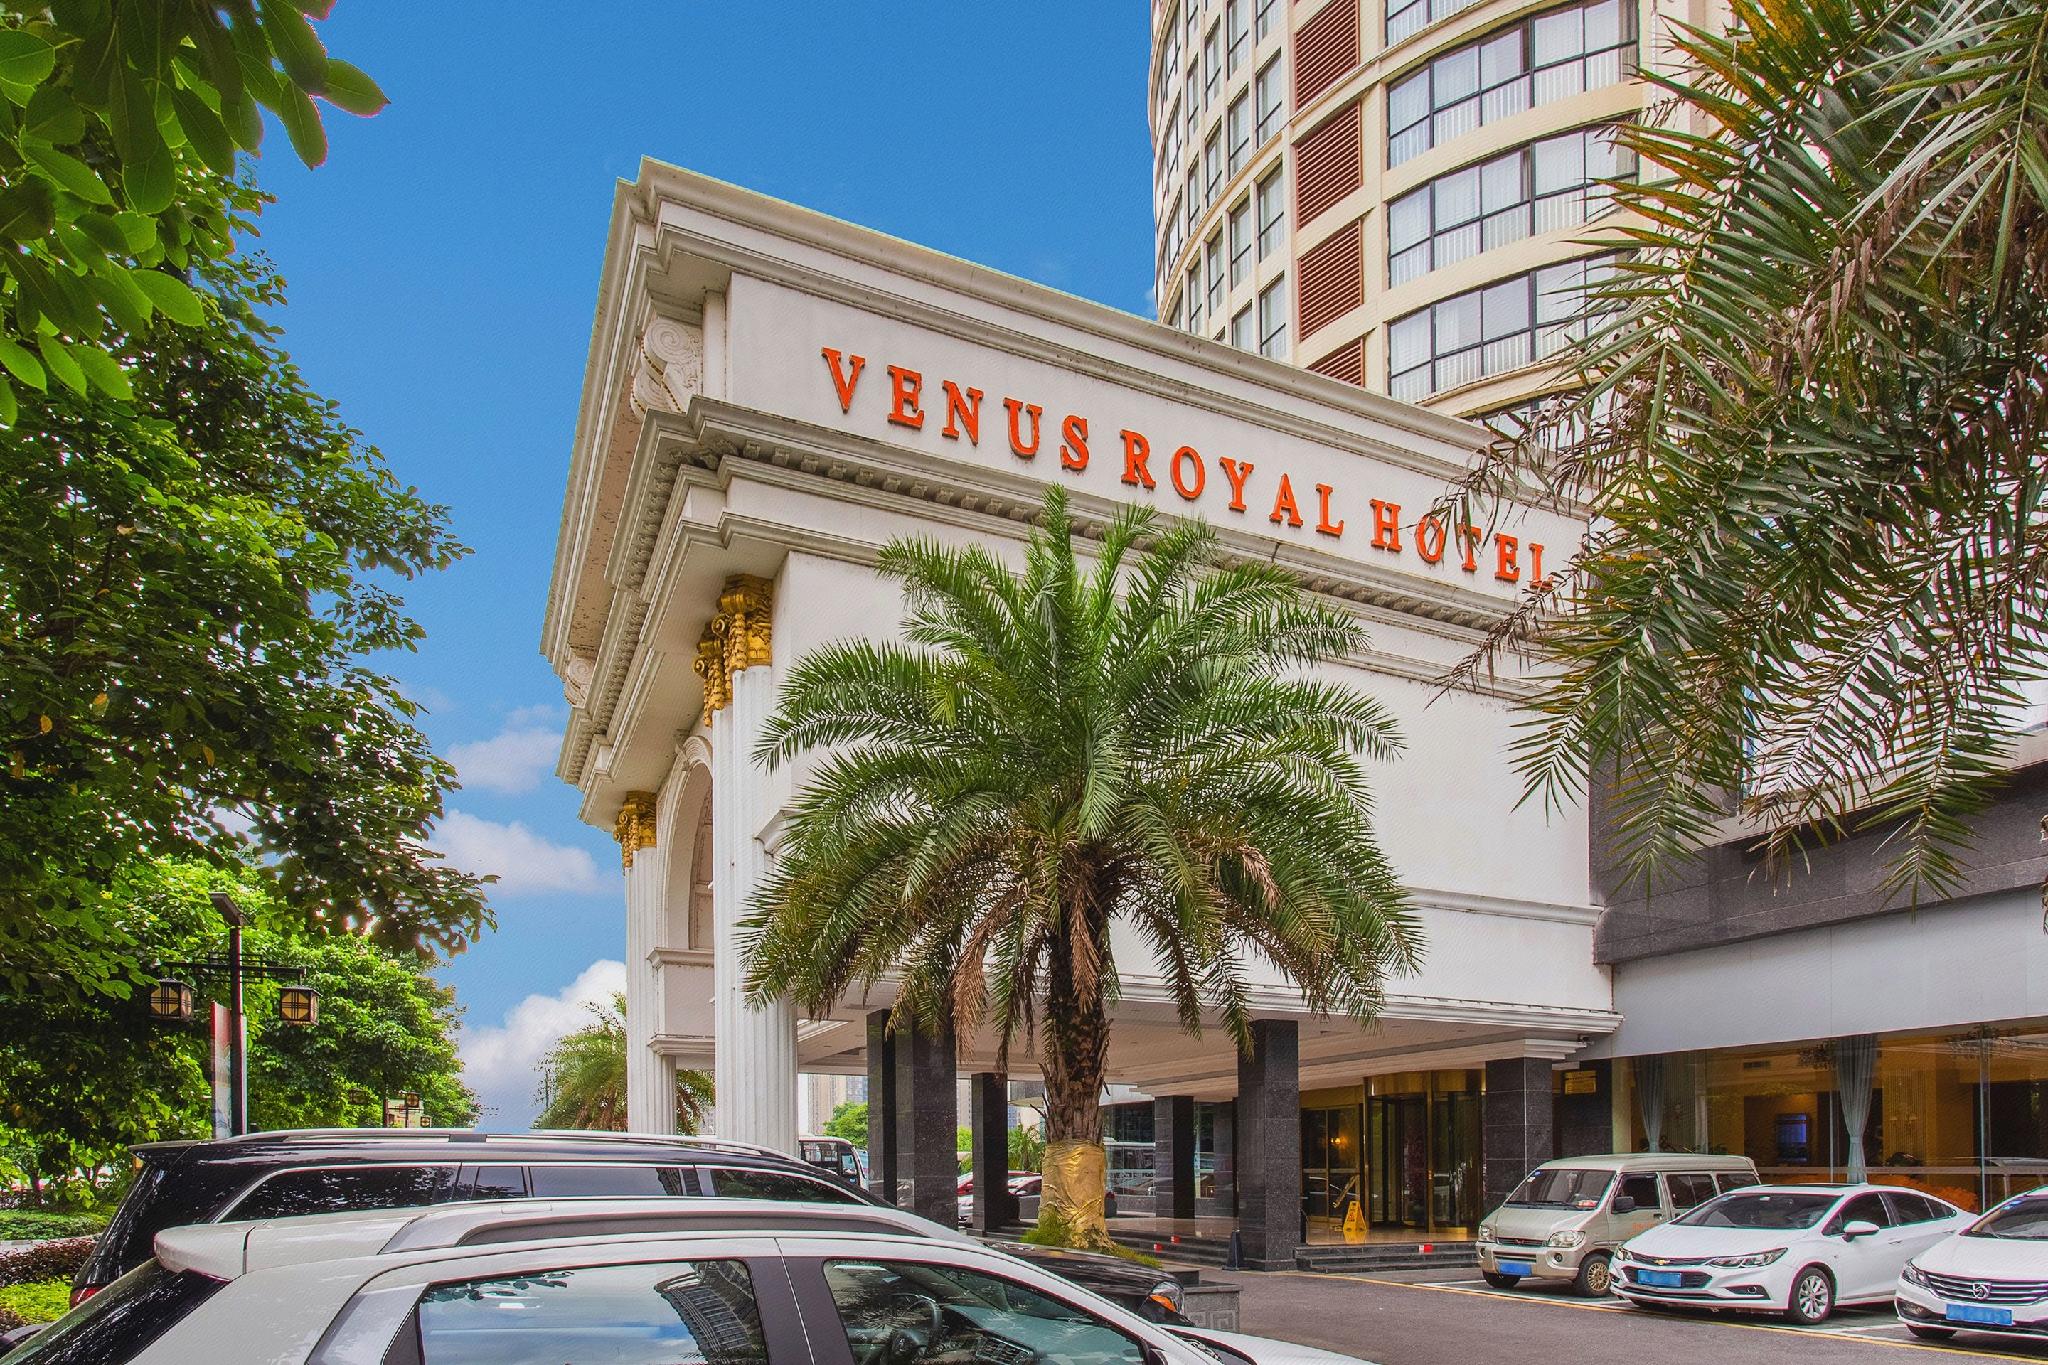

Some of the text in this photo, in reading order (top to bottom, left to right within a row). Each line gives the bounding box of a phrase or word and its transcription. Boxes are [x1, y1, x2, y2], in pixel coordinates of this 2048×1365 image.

[822, 346, 1553, 591] VENUS ROYAL HOTEL
